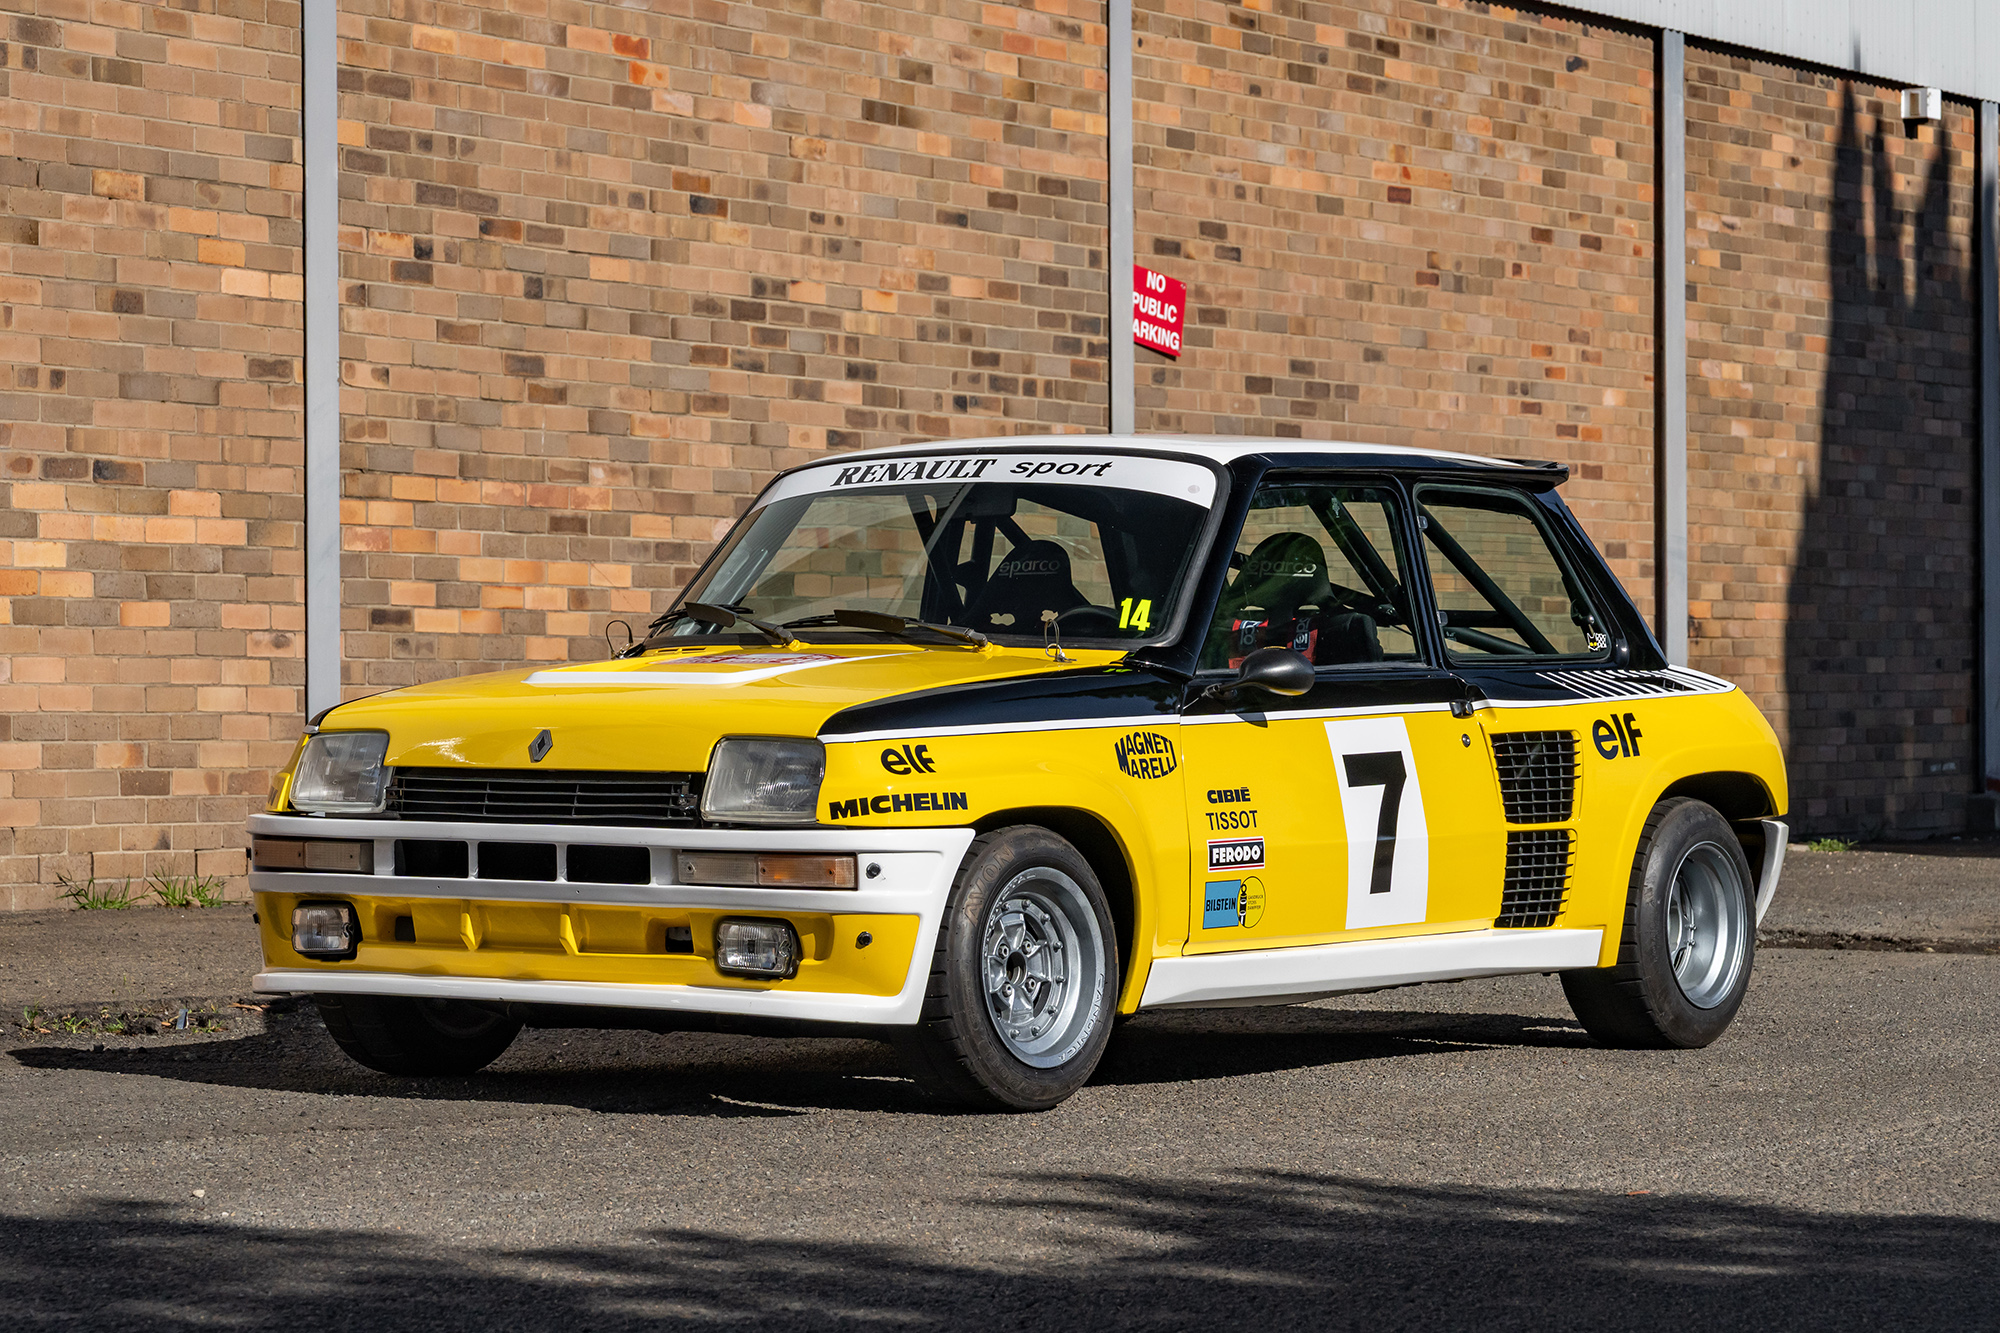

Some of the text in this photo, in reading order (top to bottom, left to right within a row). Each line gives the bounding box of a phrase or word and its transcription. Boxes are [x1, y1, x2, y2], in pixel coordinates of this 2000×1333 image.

[1146, 270, 1166, 293] NO
[1132, 291, 1177, 323] PUBLIC
[1132, 318, 1180, 351] ARKING
[830, 459, 1113, 487] RENAULT sport
[999, 559, 1061, 577] sparco
[1118, 597, 1151, 631] 14
[1114, 731, 1177, 757] MAGNETI
[1592, 712, 1643, 760] elf
[880, 744, 936, 775] elf
[829, 792, 968, 820] MICHELIN
[1205, 809, 1258, 831] TISSOT
[1341, 750, 1407, 894] 7
[1212, 845, 1261, 864] FERODO
[964, 845, 1016, 928] AVON
[1206, 897, 1237, 912] BILSTEIN
